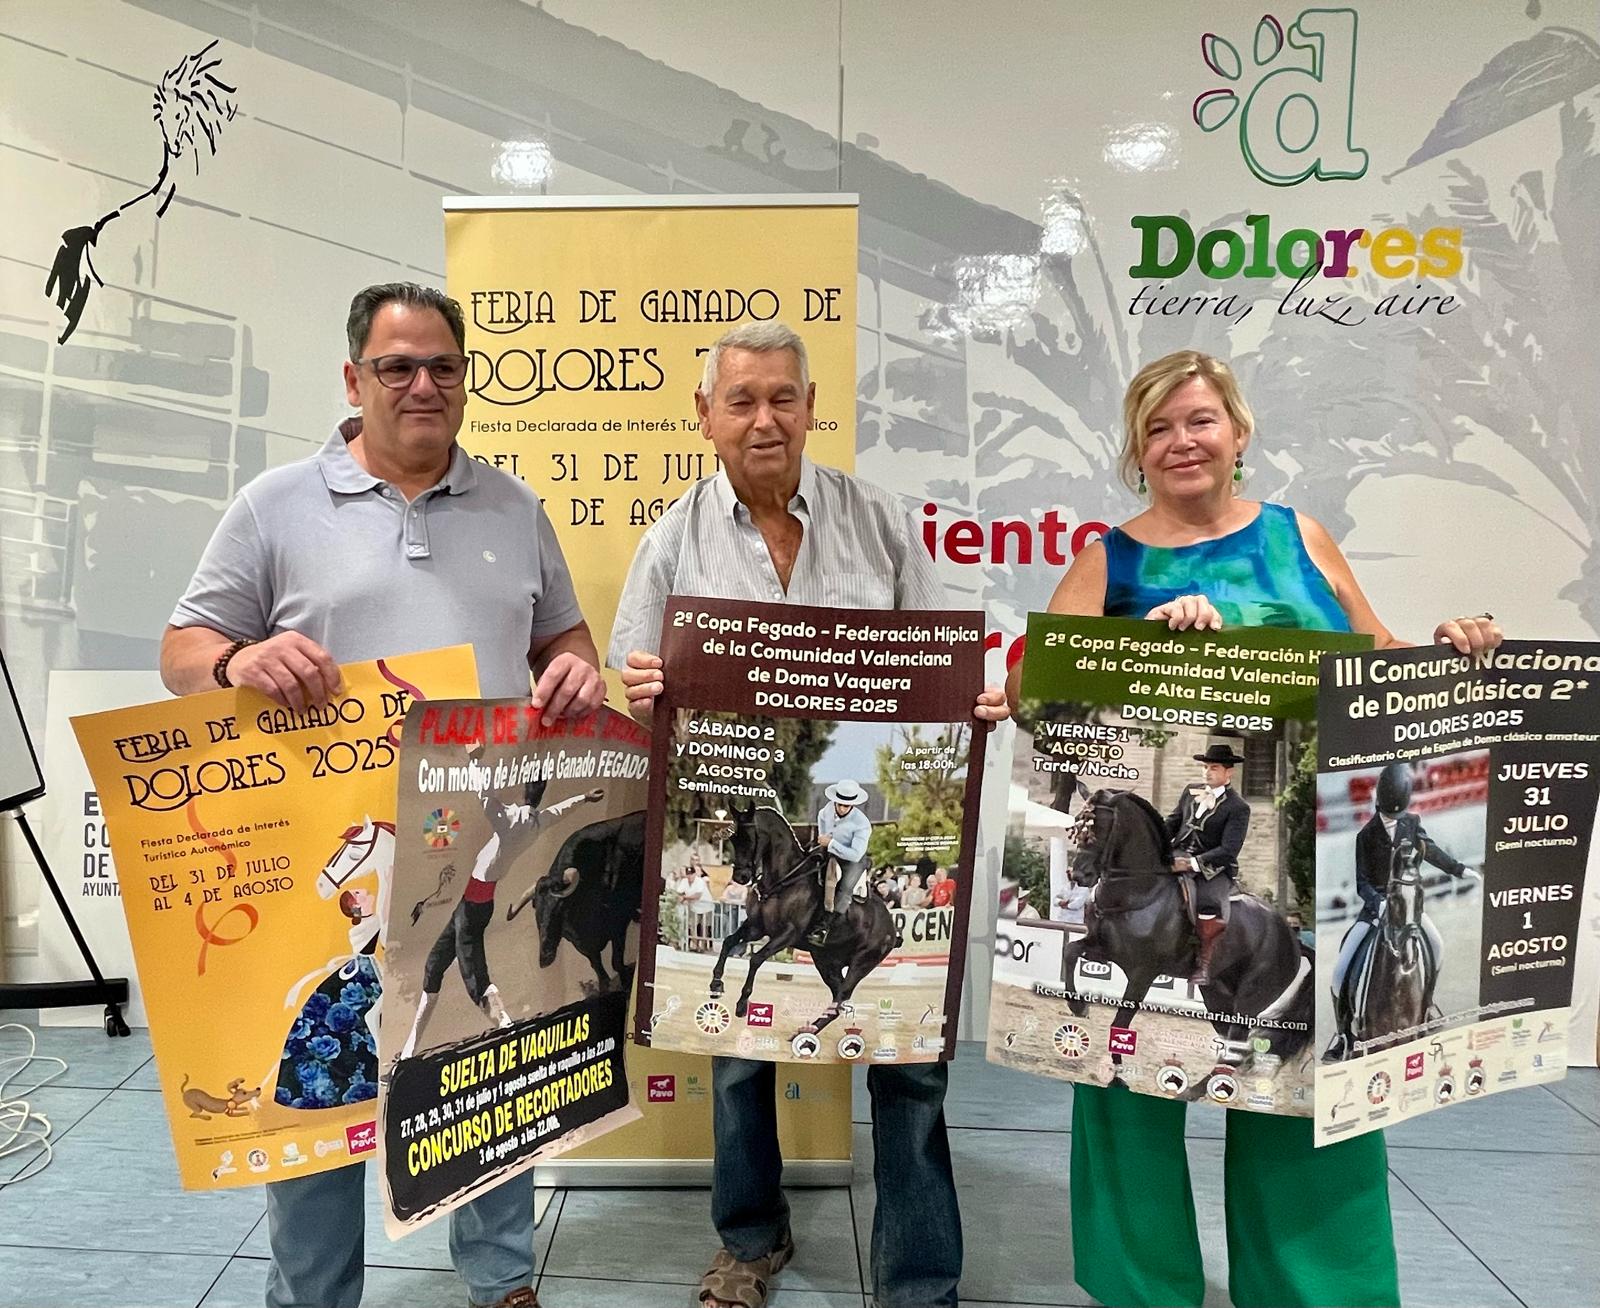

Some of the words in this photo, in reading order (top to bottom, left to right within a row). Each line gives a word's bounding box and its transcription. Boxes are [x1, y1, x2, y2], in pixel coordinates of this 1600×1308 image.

[1128, 214, 1463, 279] Dolores
[471, 292, 555, 334] FERIA
[580, 290, 617, 323] DE
[640, 289, 780, 323] GANADO
[803, 288, 841, 323] DE
[1128, 285, 1254, 324] tierra,
[1374, 284, 1461, 316] aire
[468, 348, 664, 405] DOLORES
[471, 420, 511, 433] Fiesta
[516, 419, 597, 433] Declarada
[602, 419, 622, 433] de
[627, 418, 676, 433] Interés
[551, 454, 578, 481] 31
[604, 454, 638, 481] DE
[571, 499, 604, 525] DE
[673, 611, 692, 627] 2ª
[696, 612, 743, 633] Copa
[747, 617, 816, 640] Fegado
[834, 624, 931, 642] Federación
[934, 626, 979, 645] Hípica
[702, 639, 726, 656] de
[730, 640, 746, 656] la
[750, 642, 855, 665] Comunidad
[861, 650, 952, 666] Valenciana
[1045, 633, 1065, 647] 2ª
[1069, 634, 1115, 652] Copa
[1119, 637, 1185, 658] Fegado
[1204, 642, 1305, 663] Federación
[747, 667, 770, 682] de
[775, 669, 829, 687] Doma
[834, 673, 911, 693] Vaquera
[1075, 657, 1098, 671] de
[1102, 658, 1116, 672] la
[1121, 658, 1226, 680] Comunidad
[1336, 657, 1362, 687] III
[1369, 656, 1469, 683] Concurso
[755, 692, 845, 711] DOLORES
[849, 699, 898, 713] 2025
[1129, 681, 1151, 696] de
[1155, 684, 1195, 700] Alta
[1200, 687, 1271, 706] Escuela
[1349, 696, 1379, 719] de
[1386, 691, 1449, 715] Doma
[1454, 678, 1542, 705] Clásica
[114, 728, 191, 763] FERIA
[206, 717, 240, 745] DE
[381, 690, 410, 718] DE
[419, 707, 485, 745] PLAZA
[494, 707, 518, 745] DE
[688, 719, 761, 739] SÁBADO
[764, 728, 775, 741] 2
[1122, 705, 1218, 727] DOLORES
[1222, 715, 1273, 731] 2025
[1394, 714, 1469, 743] DOLORES
[1472, 709, 1524, 729] 2025
[1045, 723, 1118, 742] VIERNES
[1119, 728, 1129, 742] 1
[676, 743, 685, 757] y
[688, 742, 770, 761] DOMINGO
[774, 750, 785, 763] 3
[916, 747, 942, 756] partir
[944, 746, 955, 754] de
[1050, 743, 1123, 759] AGOSTO
[1328, 751, 1395, 767] Clasificatorio
[1397, 748, 1420, 760] Copa
[1421, 745, 1432, 754] de
[1462, 737, 1473, 746] de
[1474, 734, 1502, 744] Doma
[1503, 732, 1542, 742] clásica
[1545, 732, 1600, 741] amateur
[123, 752, 286, 812] DOLORES
[306, 736, 395, 778] 2025
[418, 759, 444, 792] Con
[448, 759, 490, 792] motivo
[494, 758, 508, 789] de
[508, 754, 517, 787] la
[518, 753, 540, 784] Feria
[542, 752, 554, 780] de
[556, 750, 595, 778] Ganado
[596, 750, 648, 779] FEGADO
[696, 764, 766, 781] AGOSTO
[901, 761, 916, 769] las
[1032, 758, 1139, 780] Tarde/Noche
[1497, 763, 1589, 781] JUEVES
[678, 778, 777, 798] Seminocturno
[1524, 787, 1552, 806] 31
[141, 838, 173, 848] Fiesta
[176, 828, 234, 843] Declarada
[237, 825, 251, 834] de
[254, 818, 290, 831] Interés
[1503, 814, 1568, 834] JULIO
[144, 849, 186, 863] Turístico
[191, 839, 251, 854] Autonómico
[1524, 836, 1577, 848] nocturno)
[84, 853, 109, 878] DE
[150, 873, 178, 894] DEL
[189, 870, 205, 883] 31
[217, 864, 235, 879] DE
[245, 856, 290, 877] JULIO
[154, 897, 172, 911] AL
[184, 892, 192, 906] 4
[203, 888, 222, 904] DE
[233, 876, 294, 898] AGOSTO
[1489, 885, 1574, 908] VIERNES
[1522, 912, 1533, 929] 1
[1487, 935, 1567, 961] AGOSTO
[1036, 984, 1082, 1002] Reserva
[1084, 992, 1098, 1004] de
[1101, 995, 1135, 1009] boxes
[1138, 1000, 1308, 1031] www.secretariashipicas.com
[440, 1049, 495, 1097] SUELTA
[499, 1039, 518, 1074] DE
[520, 1014, 590, 1065] VAQUILLAS
[400, 1118, 414, 1138] 27,
[415, 1113, 427, 1132] 28,
[429, 1107, 441, 1126] 29,
[442, 1102, 454, 1120] 30,
[455, 1097, 464, 1115] 31
[466, 1094, 475, 1110] de
[492, 1087, 497, 1104] y
[499, 1082, 502, 1096] 1
[549, 1061, 556, 1076] de
[650, 1089, 673, 1097] Pavo
[408, 1111, 492, 1177] CONCURSO
[495, 1101, 513, 1137] DE
[517, 1058, 613, 1127] RECORTADORES
[479, 1149, 484, 1165] 3
[486, 1146, 495, 1162] de
[496, 1135, 518, 1159] agosto
[521, 1133, 526, 1145] a
